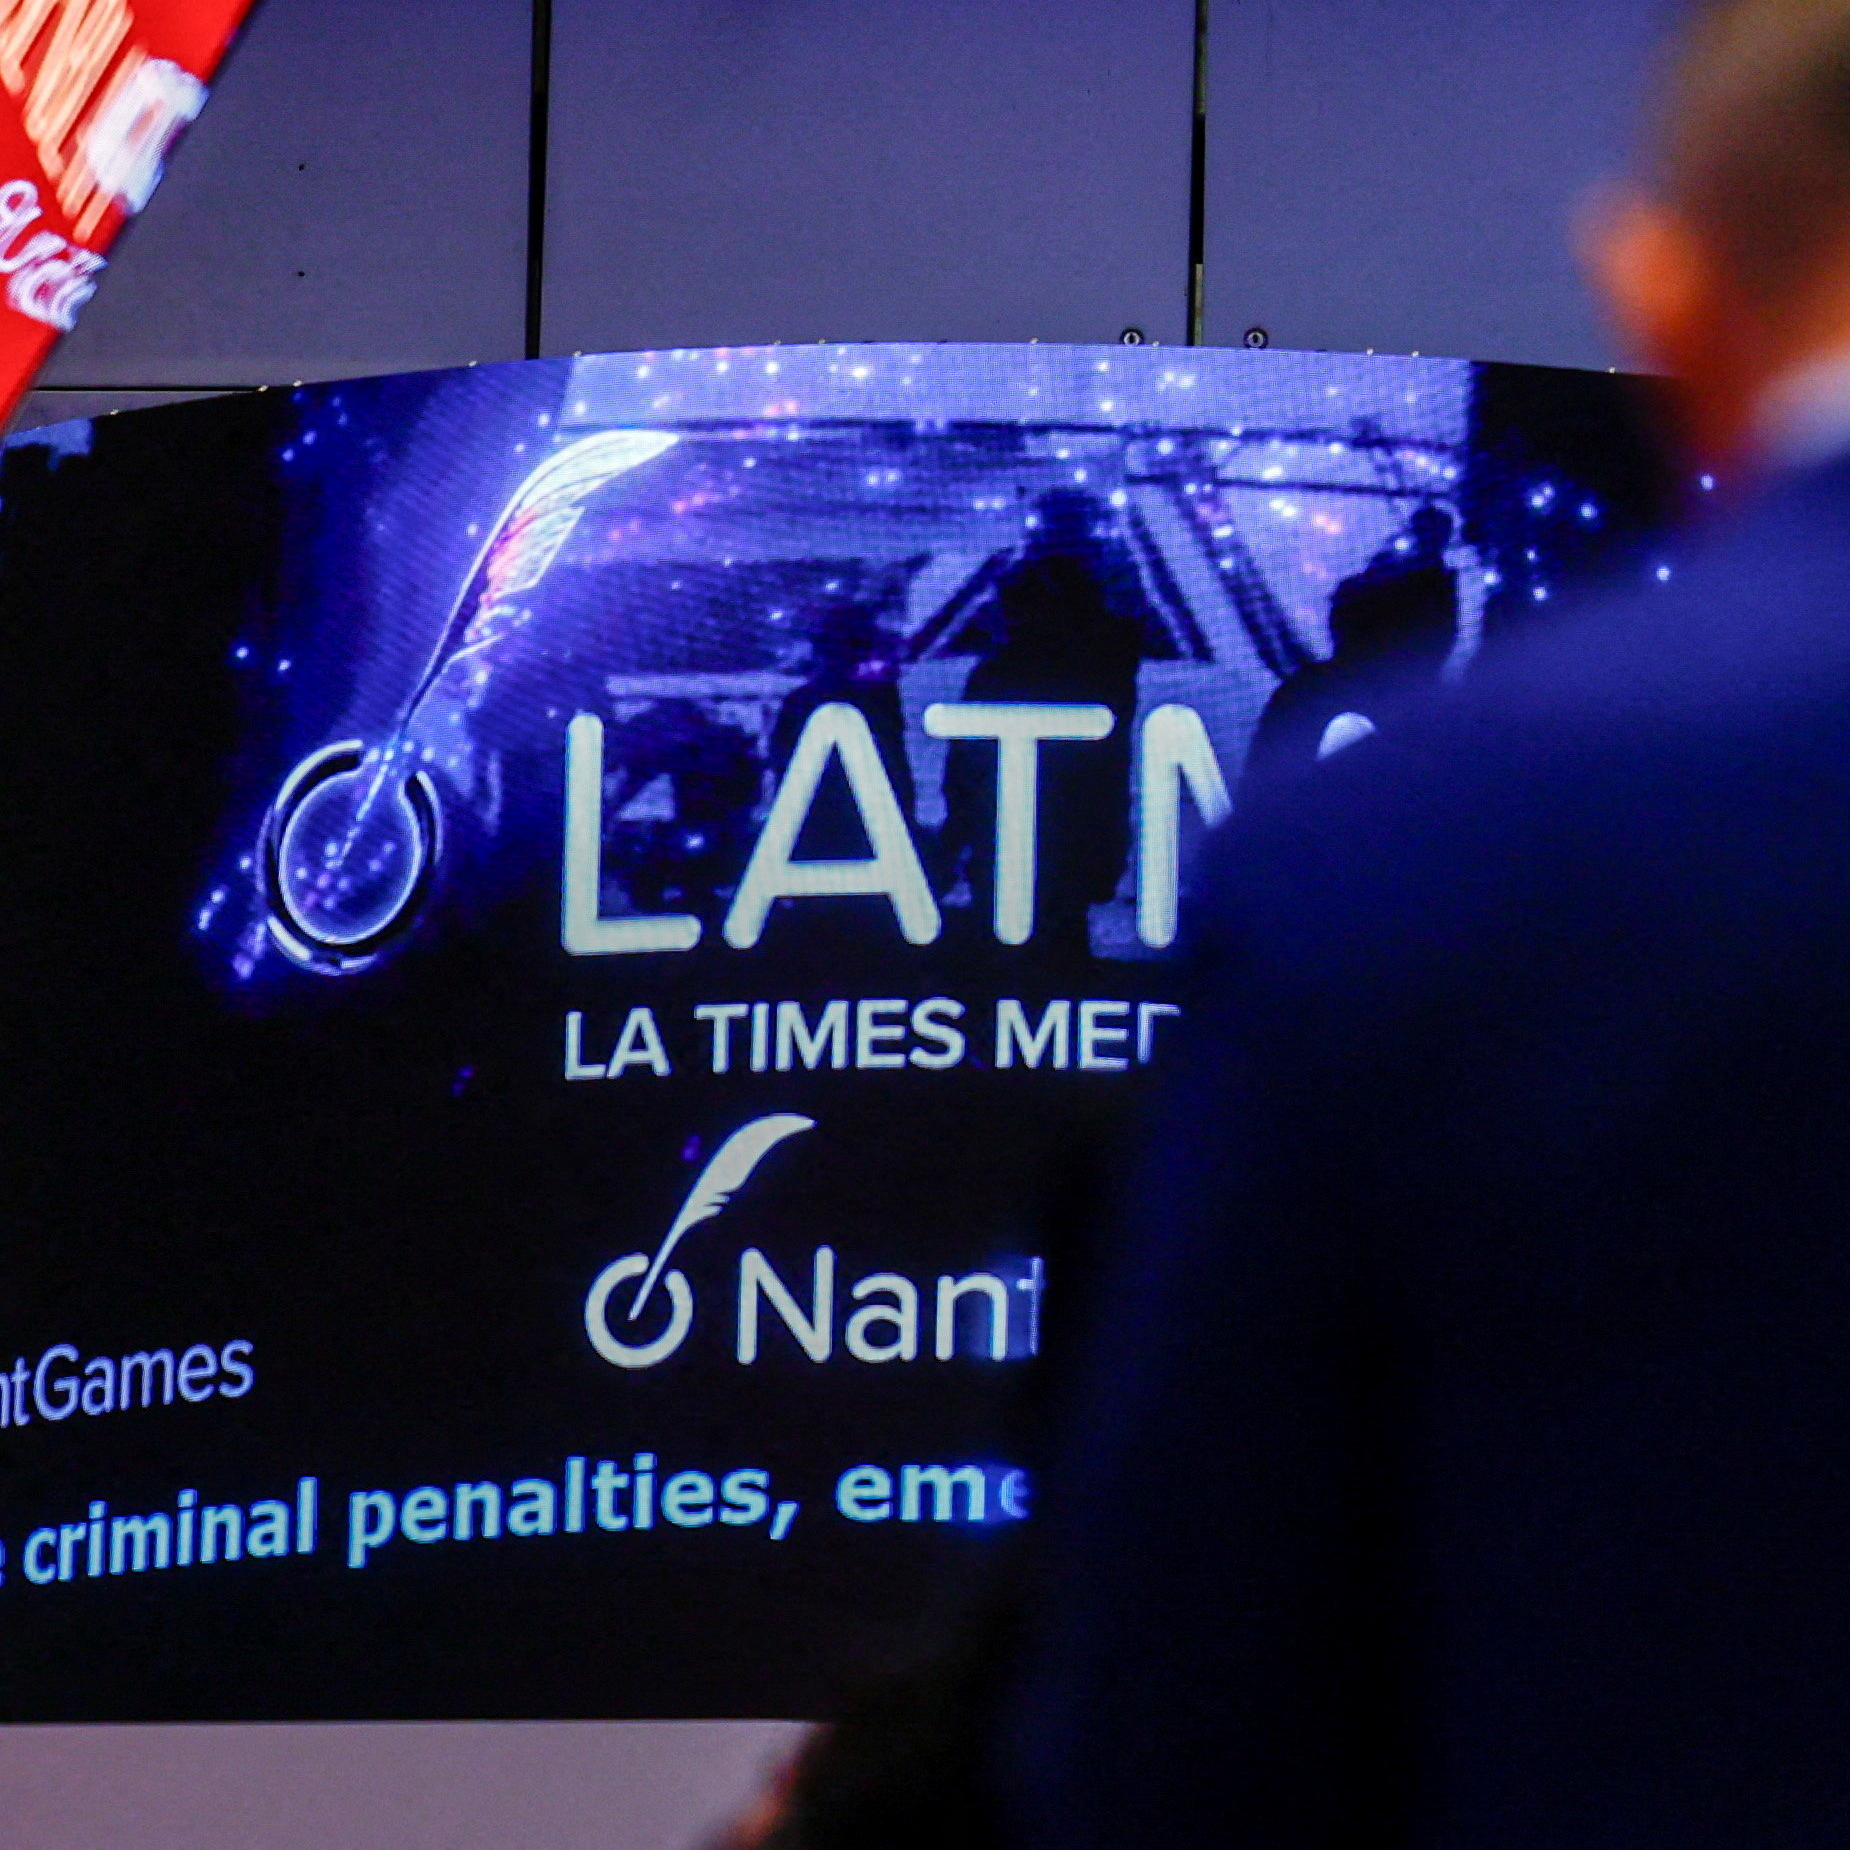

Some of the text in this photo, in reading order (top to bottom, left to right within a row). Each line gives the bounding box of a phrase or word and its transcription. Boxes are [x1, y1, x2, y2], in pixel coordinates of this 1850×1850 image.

[565, 1006, 672, 1080] LA
[694, 995, 967, 1073] TIMES
[22, 1476, 319, 1584] criminal
[347, 1451, 800, 1568] penalties,
